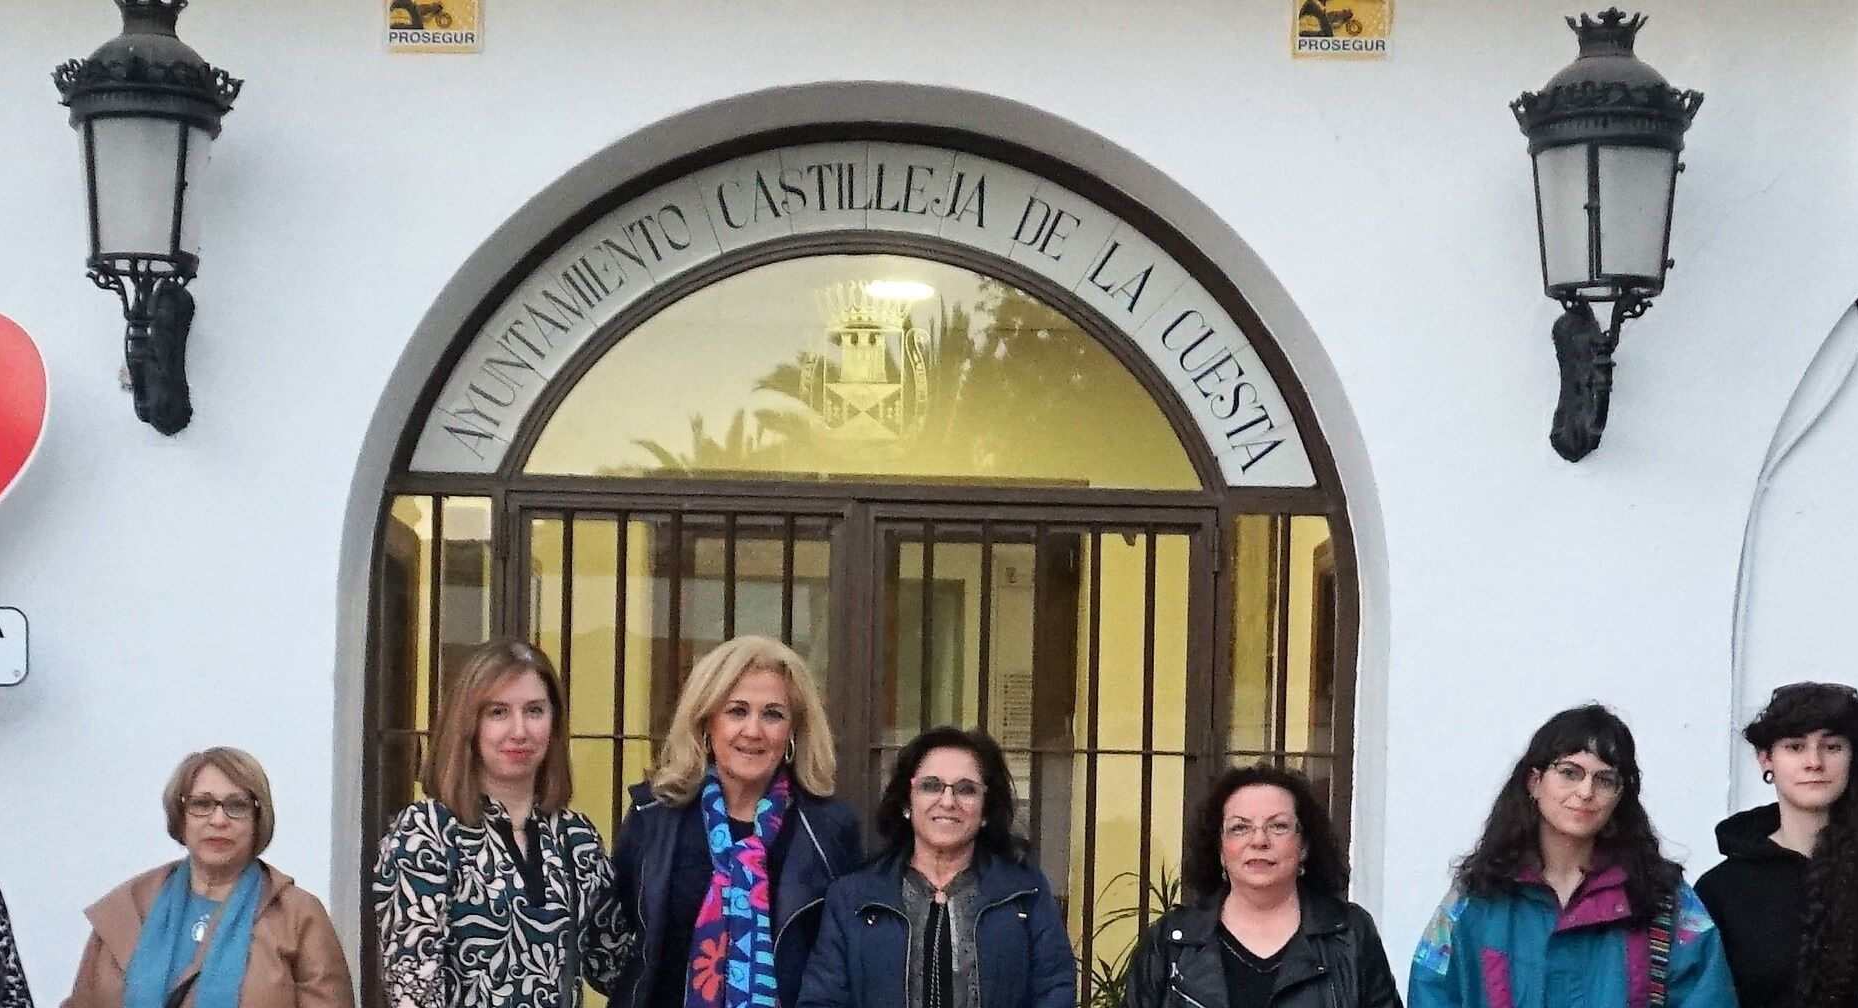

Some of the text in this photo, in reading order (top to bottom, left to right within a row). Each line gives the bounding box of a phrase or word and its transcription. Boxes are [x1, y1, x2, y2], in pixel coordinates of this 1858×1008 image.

[389, 31, 475, 44] PROSEGUR
[1298, 39, 1386, 51] PROSEGUR
[443, 162, 1286, 475] AYUNTAMIENTO CASTILLEJA DE LA CUESTA
